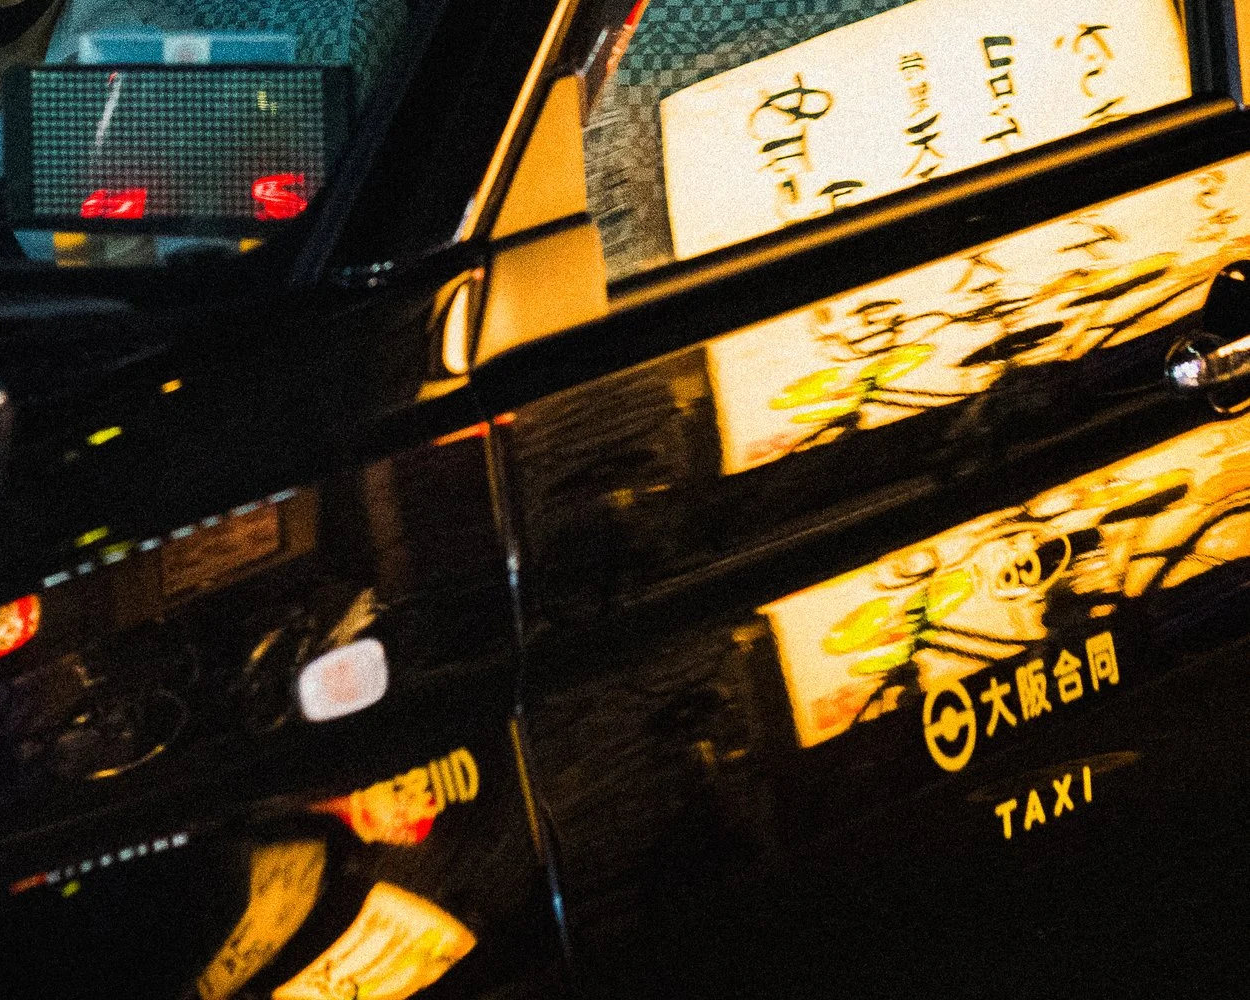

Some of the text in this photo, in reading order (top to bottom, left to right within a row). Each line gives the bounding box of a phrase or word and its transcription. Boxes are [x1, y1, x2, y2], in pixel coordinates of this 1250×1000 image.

[980, 632, 1121, 737] 大阪合同
[994, 766, 1094, 839] TAXI
